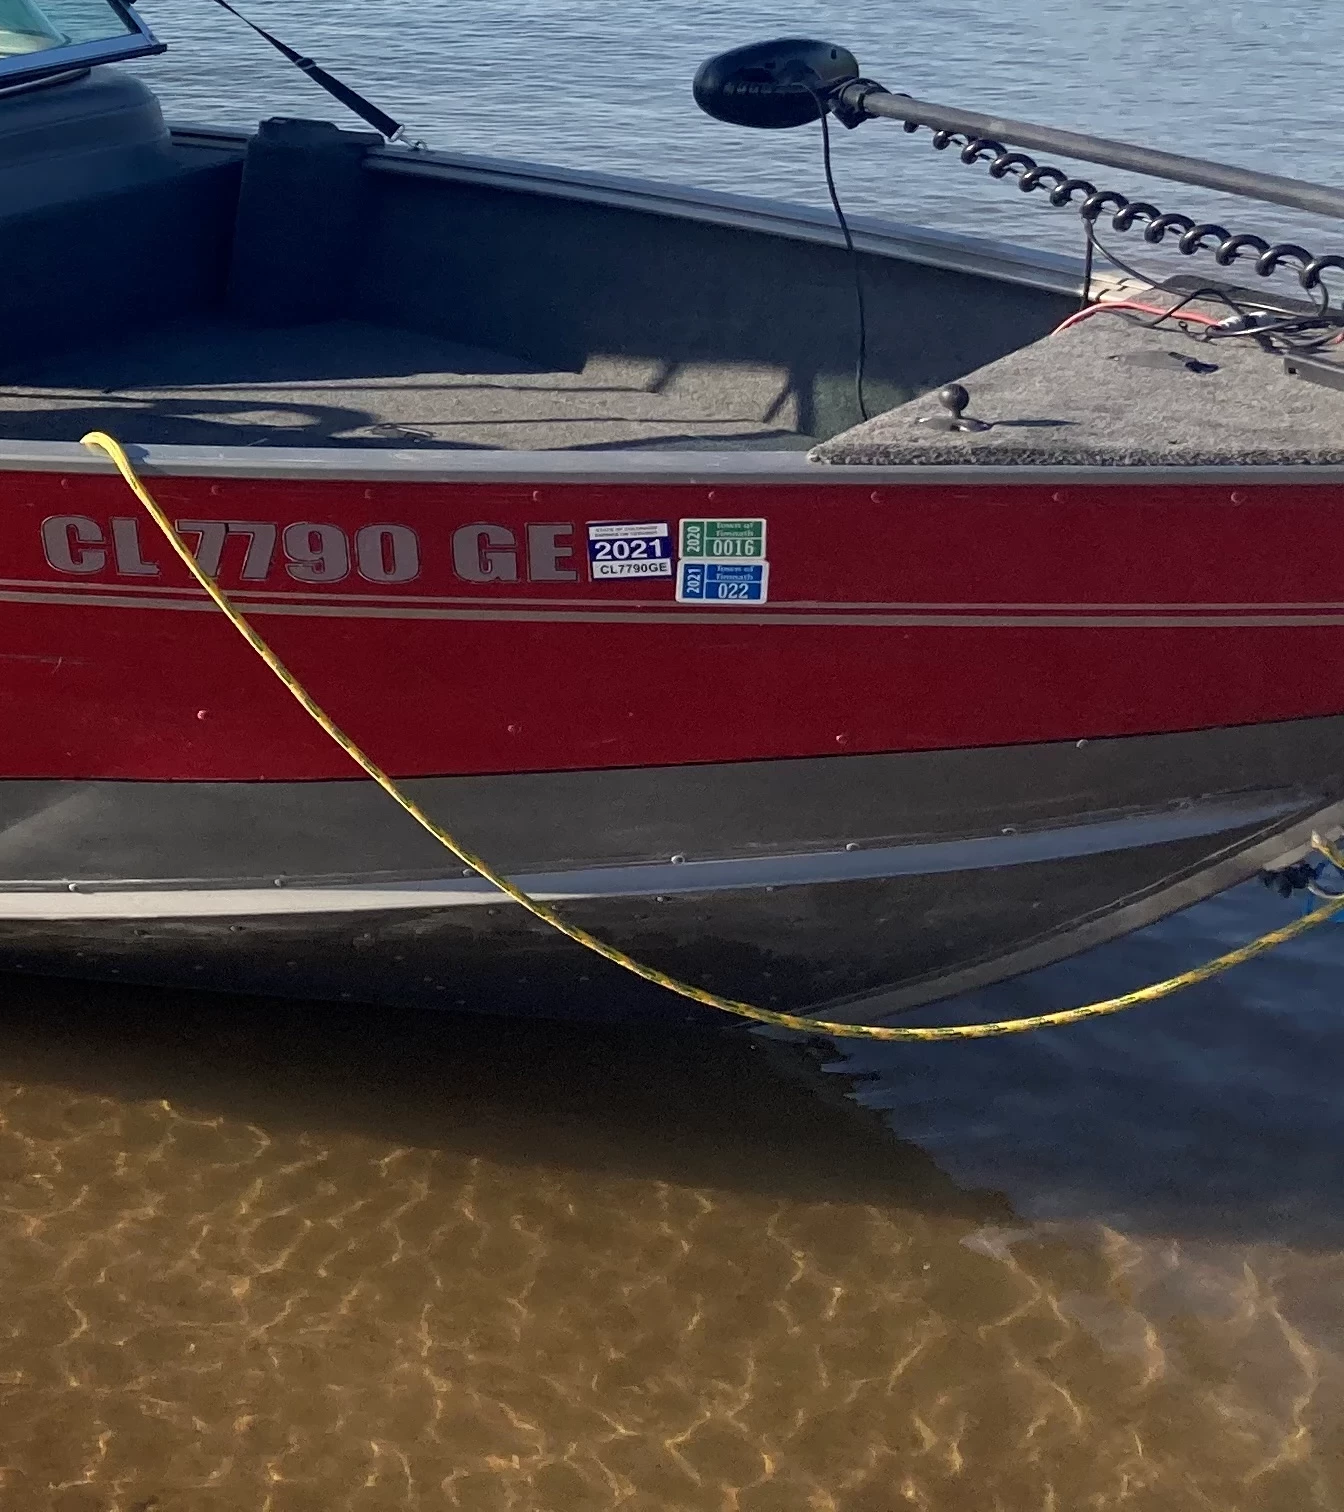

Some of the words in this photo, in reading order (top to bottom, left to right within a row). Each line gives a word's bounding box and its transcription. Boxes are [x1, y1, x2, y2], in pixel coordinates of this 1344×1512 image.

[40, 514, 160, 576] CL
[174, 519, 421, 584] 7790
[451, 521, 589, 583] GE
[594, 538, 662, 560] 2021
[687, 526, 701, 553] 2020
[713, 539, 754, 556] 0016
[600, 562, 667, 575] CL7790GE
[686, 568, 701, 594] 2021
[718, 583, 749, 599] 022
